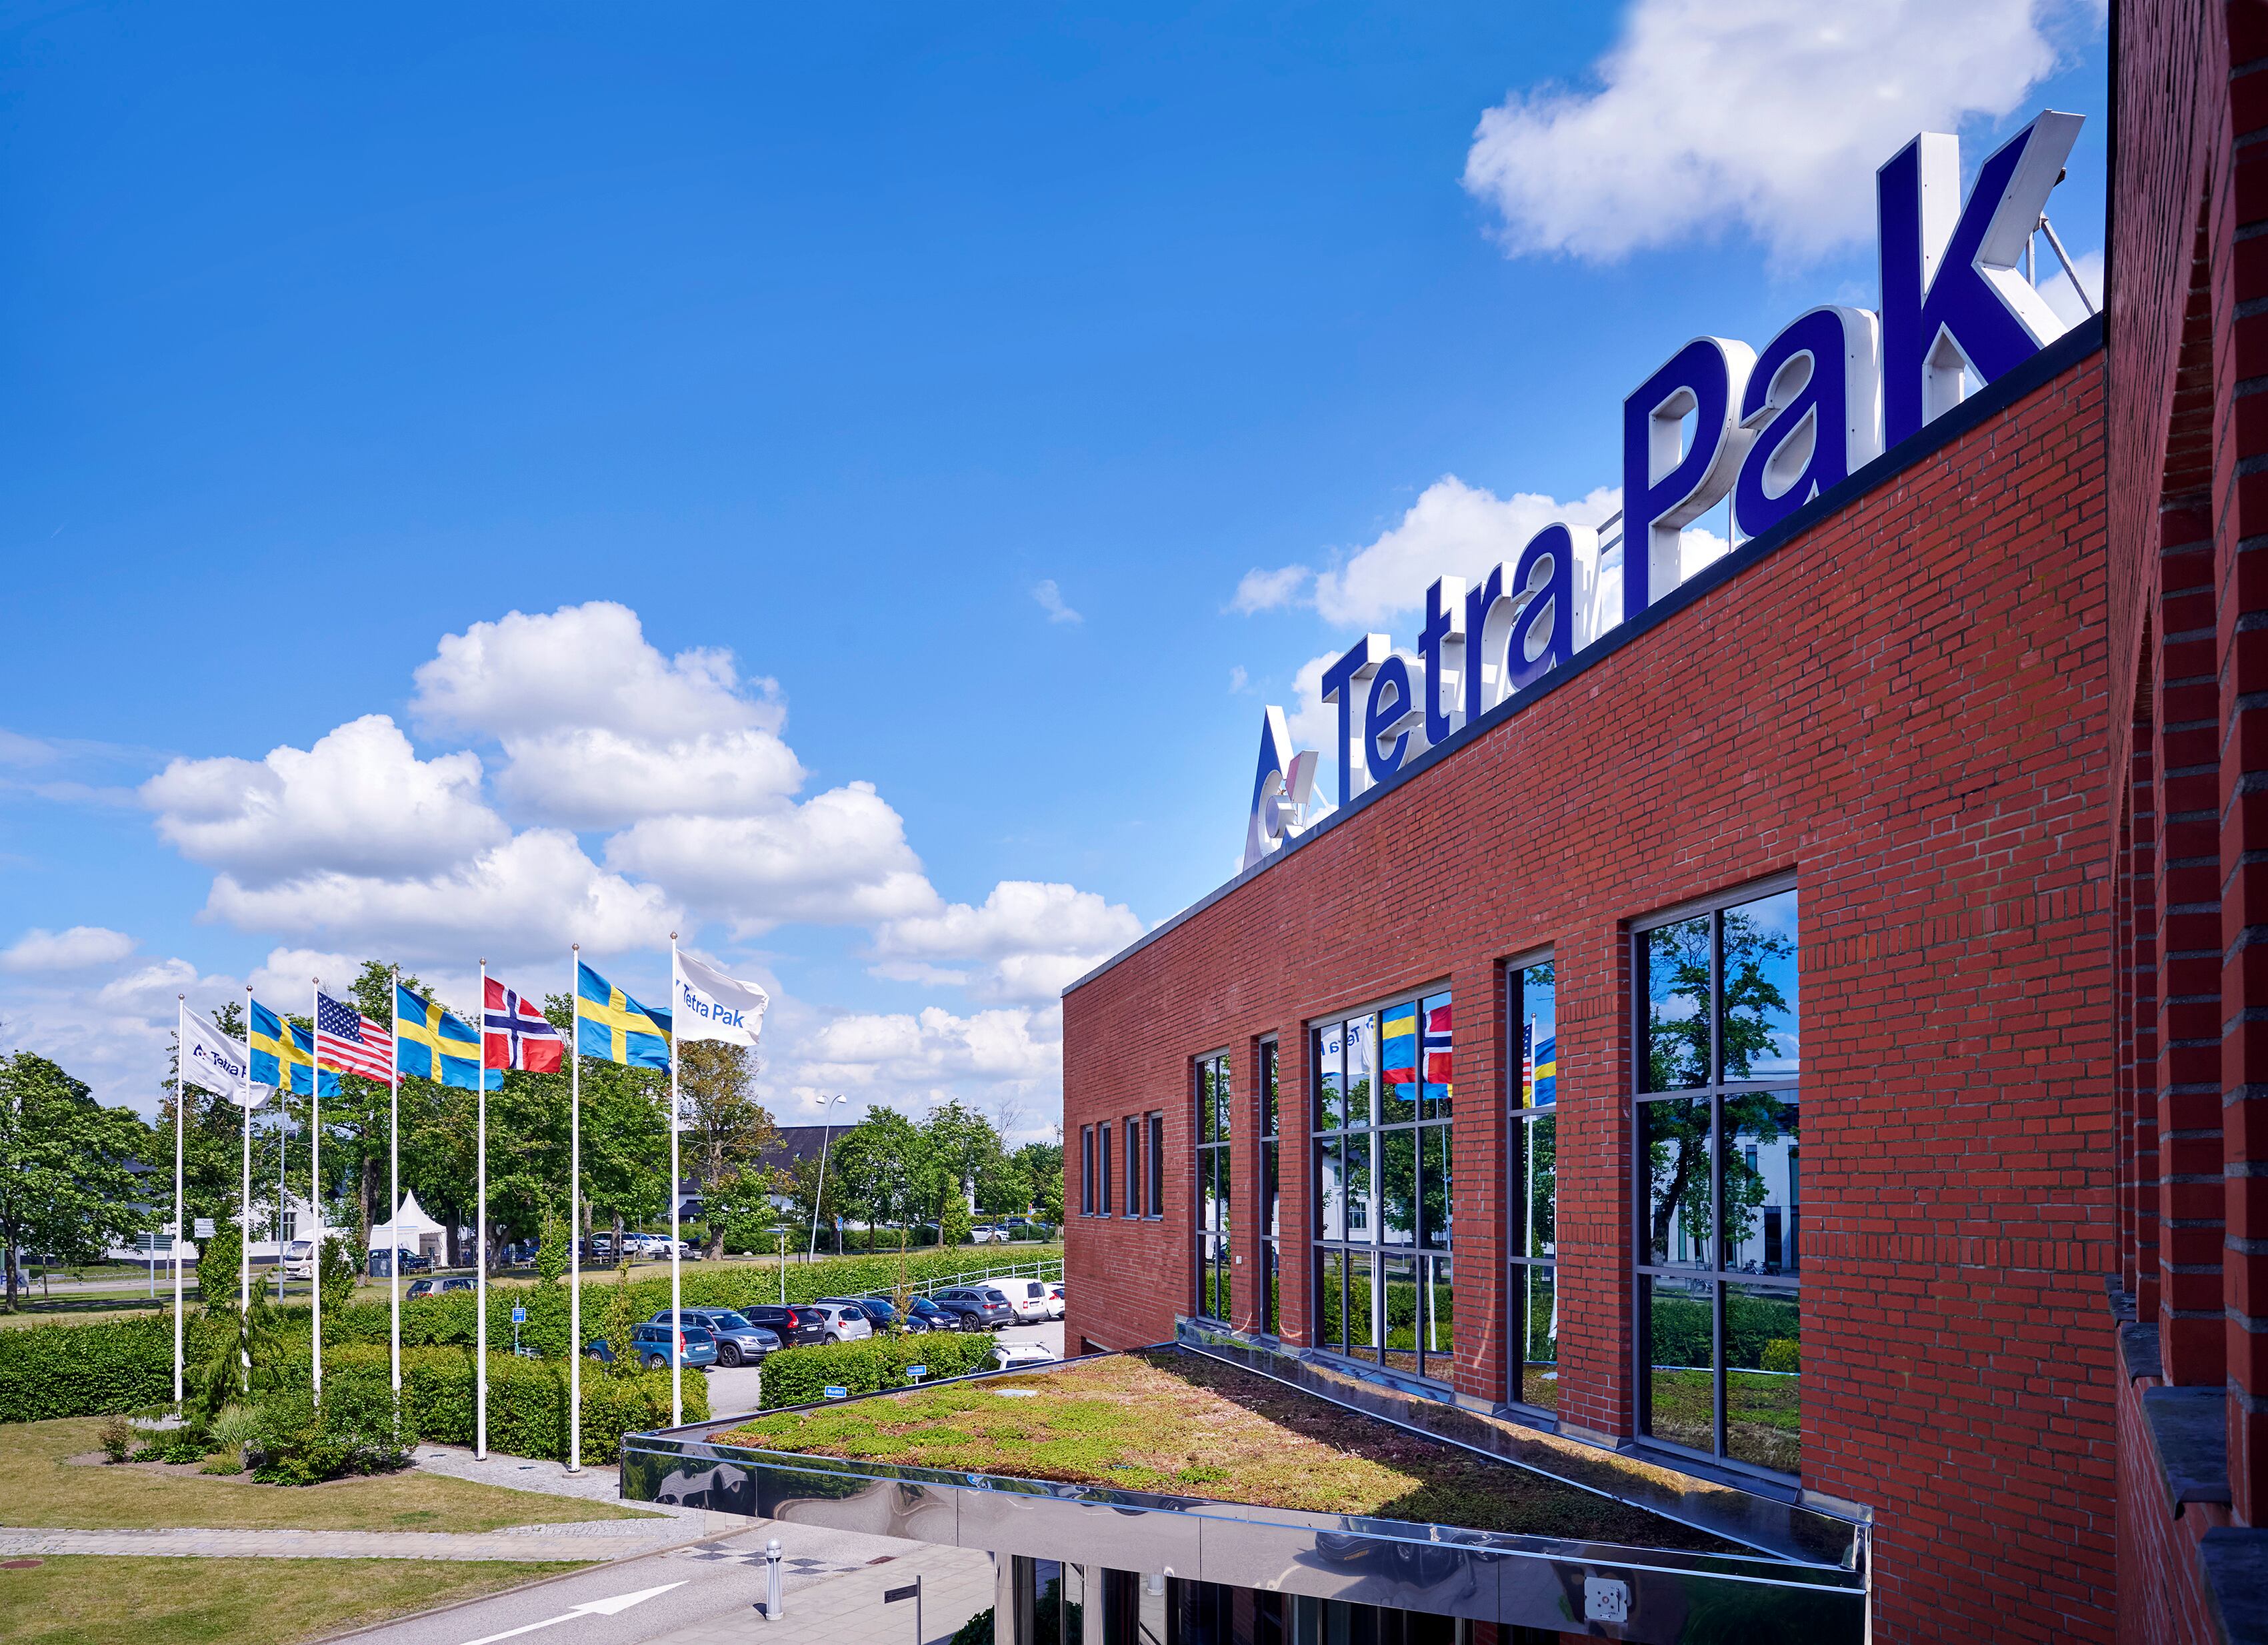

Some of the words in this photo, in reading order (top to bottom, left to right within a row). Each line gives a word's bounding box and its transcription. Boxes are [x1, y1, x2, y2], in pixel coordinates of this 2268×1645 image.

[1321, 523, 1577, 811] Tetra
[1622, 109, 2057, 621] Pak
[683, 984, 709, 1018] Tetra
[712, 1003, 745, 1028] Pak
[0, 1275, 23, 1285] Pk
